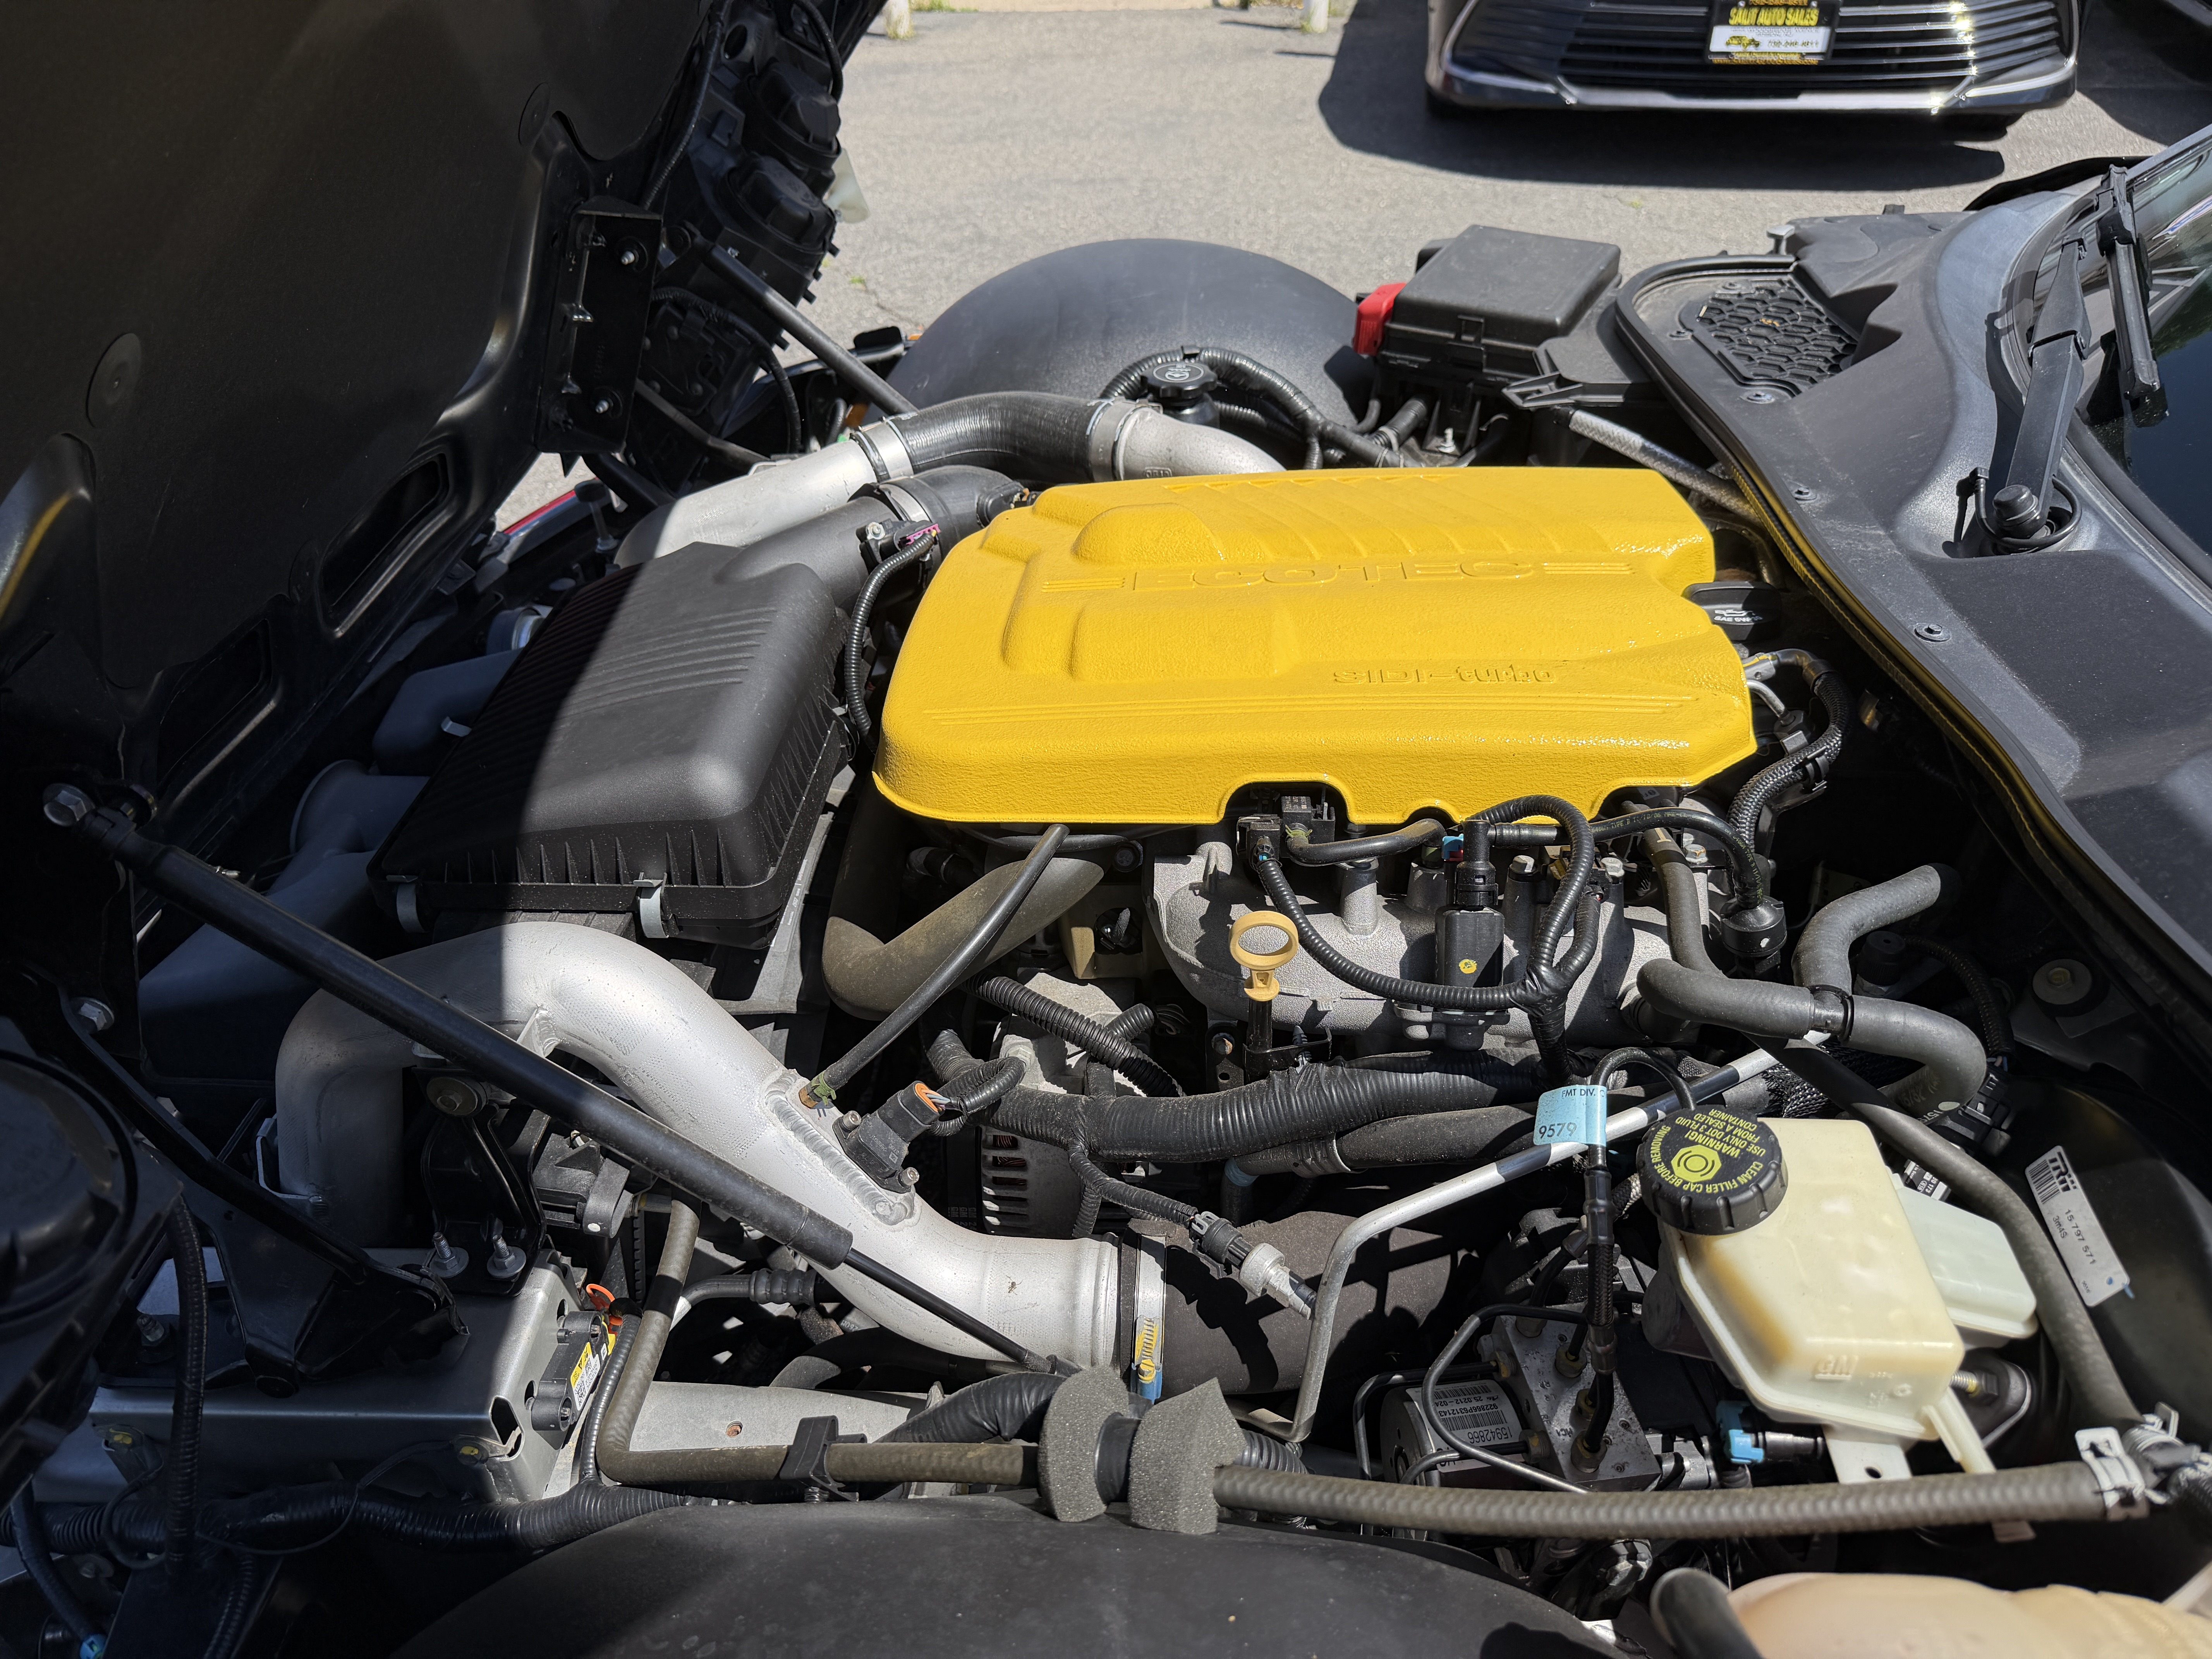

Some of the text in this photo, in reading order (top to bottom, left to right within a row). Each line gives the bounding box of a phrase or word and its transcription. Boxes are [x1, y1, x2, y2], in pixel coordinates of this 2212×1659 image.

[1757, 7, 1786, 26] AUTO
[1785, 7, 1820, 26] SALES
[1132, 561, 1534, 591] ECOTEC
[1562, 1089, 1577, 1098] FMT
[1580, 1088, 1595, 1097] DIV.
[1675, 1116, 1700, 1130] FLUID
[1693, 1113, 1760, 1143] FROM A SEALED
[1709, 1108, 1757, 1132] CONTAINER
[1539, 1122, 1577, 1139] 9579
[1705, 1127, 1724, 1140] DOT
[1685, 1130, 1740, 1158] WARNING!
[1723, 1134, 1747, 1149] ONLY
[1746, 1143, 1766, 1157] USE
[1650, 1125, 1763, 1194] CLEAN FILLER CAP BEFORE REMOVING
[1925, 1184, 1934, 1193] 173
[2065, 1209, 2096, 1264] 15 797 571
[1438, 1403, 1498, 1417] 922866P6312143
[1468, 1426, 1513, 1444] 15942866
